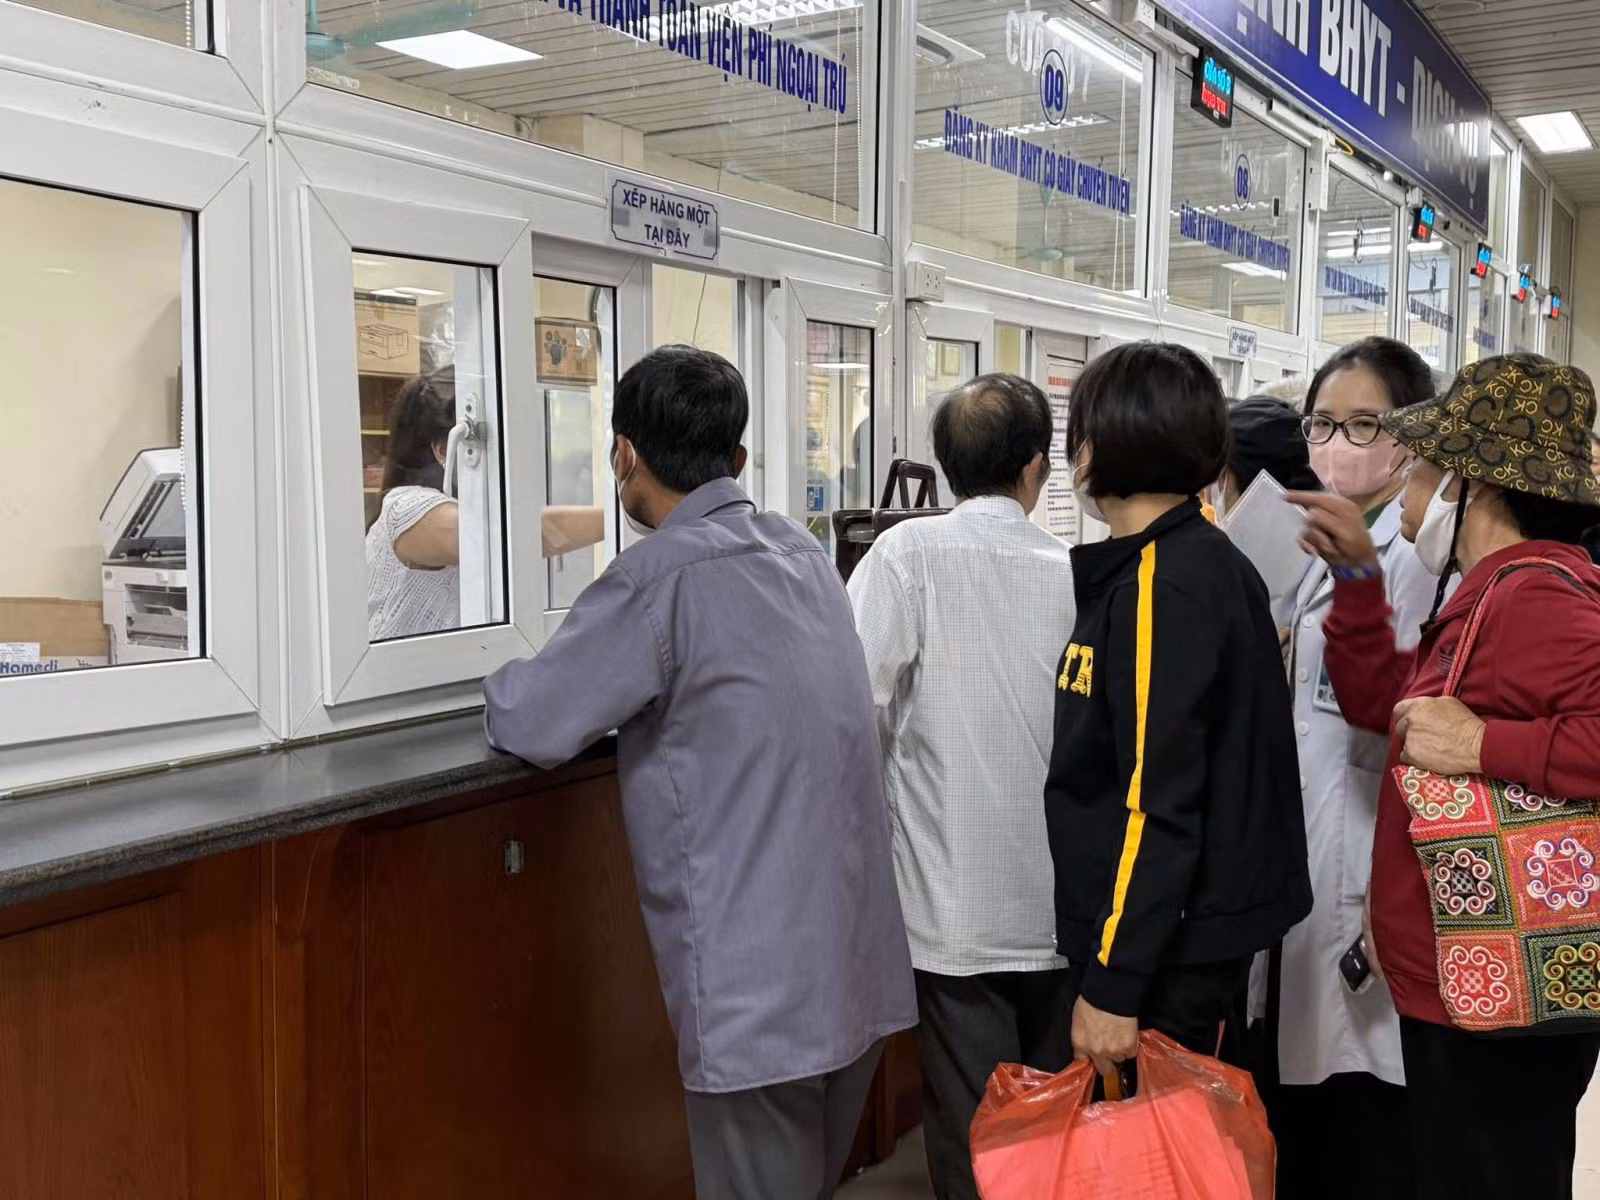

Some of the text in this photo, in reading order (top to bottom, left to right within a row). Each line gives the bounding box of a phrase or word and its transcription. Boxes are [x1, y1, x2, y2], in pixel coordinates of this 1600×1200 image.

[707, 5, 743, 82] VIỆN
[748, 24, 773, 87] PHÍ
[776, 39, 819, 112] NGOẠI
[823, 54, 847, 114] TRÚ
[1319, 0, 1392, 118] BHYT
[1044, 64, 1064, 112] 09
[991, 124, 1019, 177] KHÁM
[1020, 139, 1043, 185] BHYT
[1044, 143, 1056, 189] CÓ
[1236, 166, 1248, 200] 08
[622, 187, 711, 228] XẾP HÀNG MỘT
[644, 224, 690, 249] TẠI ĐÂY
